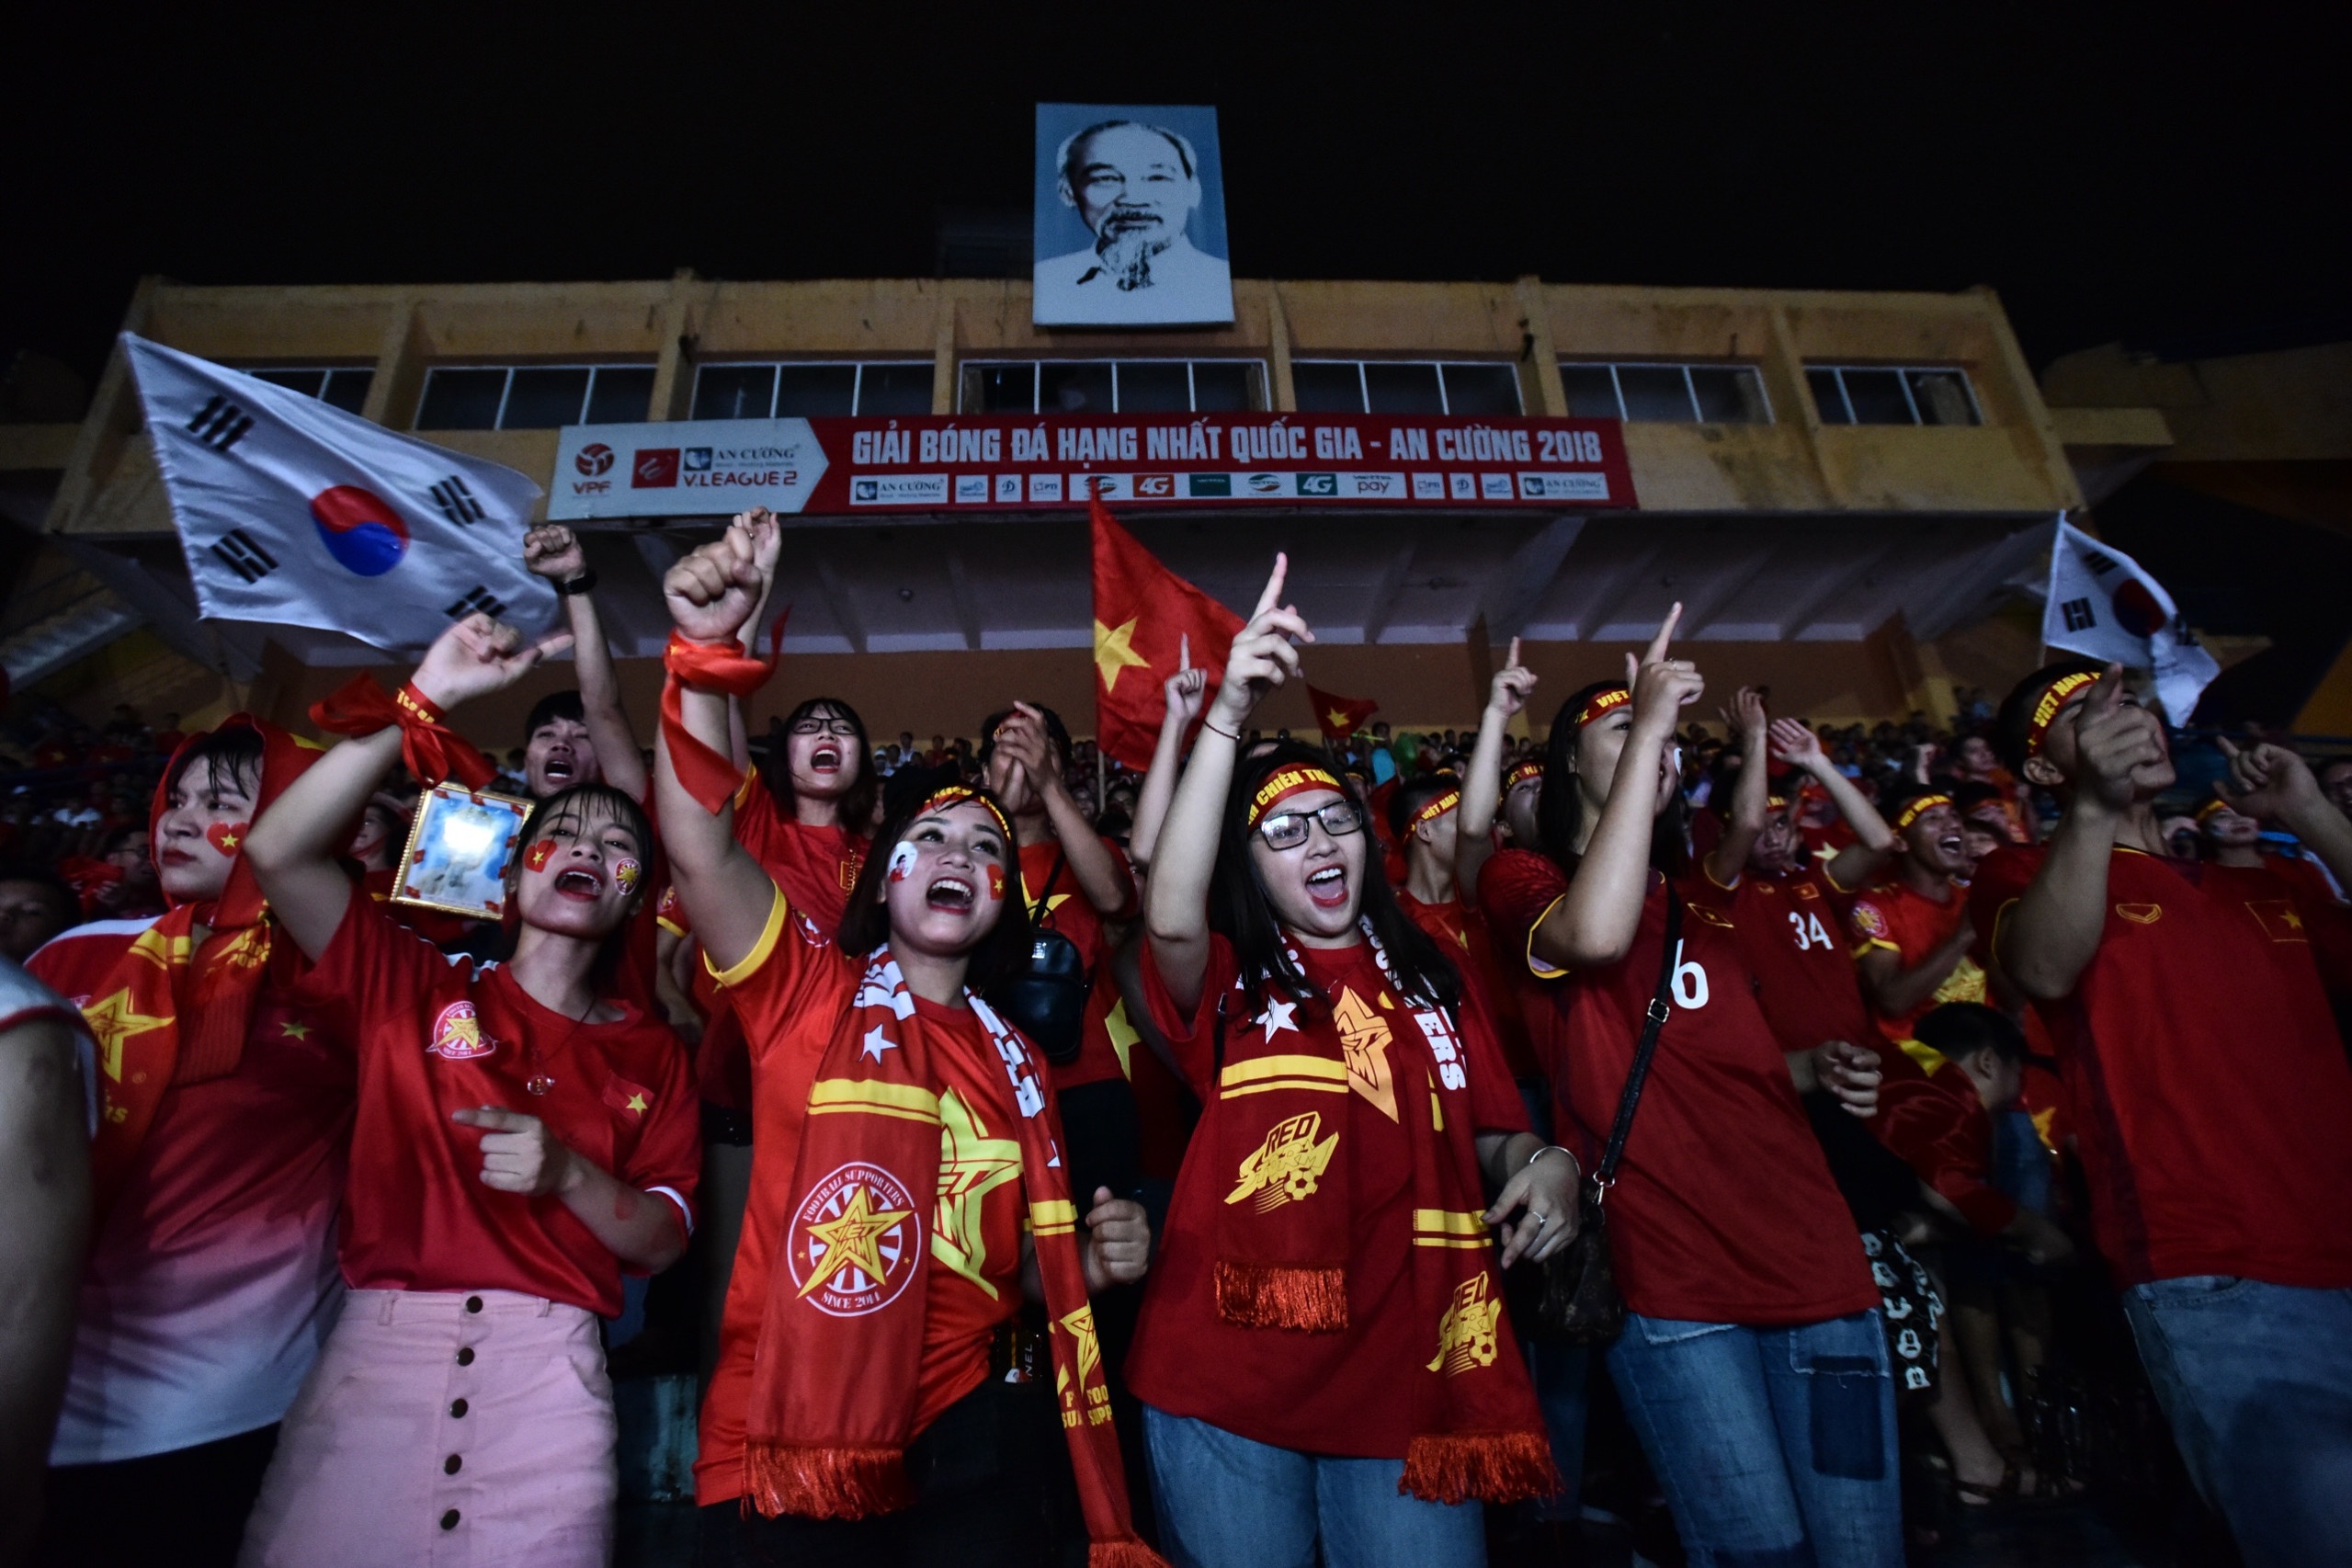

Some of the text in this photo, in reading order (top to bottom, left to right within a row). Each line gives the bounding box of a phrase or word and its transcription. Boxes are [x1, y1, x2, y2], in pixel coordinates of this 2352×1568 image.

[852, 419, 911, 465] GIẢI
[919, 423, 1001, 463] BÓNG
[1010, 421, 1050, 461] ĐÁ
[1058, 426, 1138, 470] HẠNG
[1146, 415, 1221, 460] NHẤT
[1230, 415, 1308, 463] QUỐC
[1314, 426, 1364, 460] GIA
[1390, 427, 1430, 460] AN
[1436, 423, 1532, 461] CƯỜNG
[1537, 430, 1603, 462] 2018
[718, 449, 735, 459] AN
[573, 481, 611, 494] VPF
[684, 471, 797, 486] V.LEAGUE 2
[880, 481, 896, 492] AN
[1139, 477, 1169, 494] 4G
[1302, 476, 1333, 494] 4G
[1358, 481, 1389, 494] pay
[2051, 672, 2092, 697] NAM
[1789, 911, 1834, 951] 34
[1265, 1113, 1316, 1158] RED
[802, 1169, 905, 1221] FOOTBALL SUPPORTERS
[821, 1290, 881, 1309] SINCE 2014
